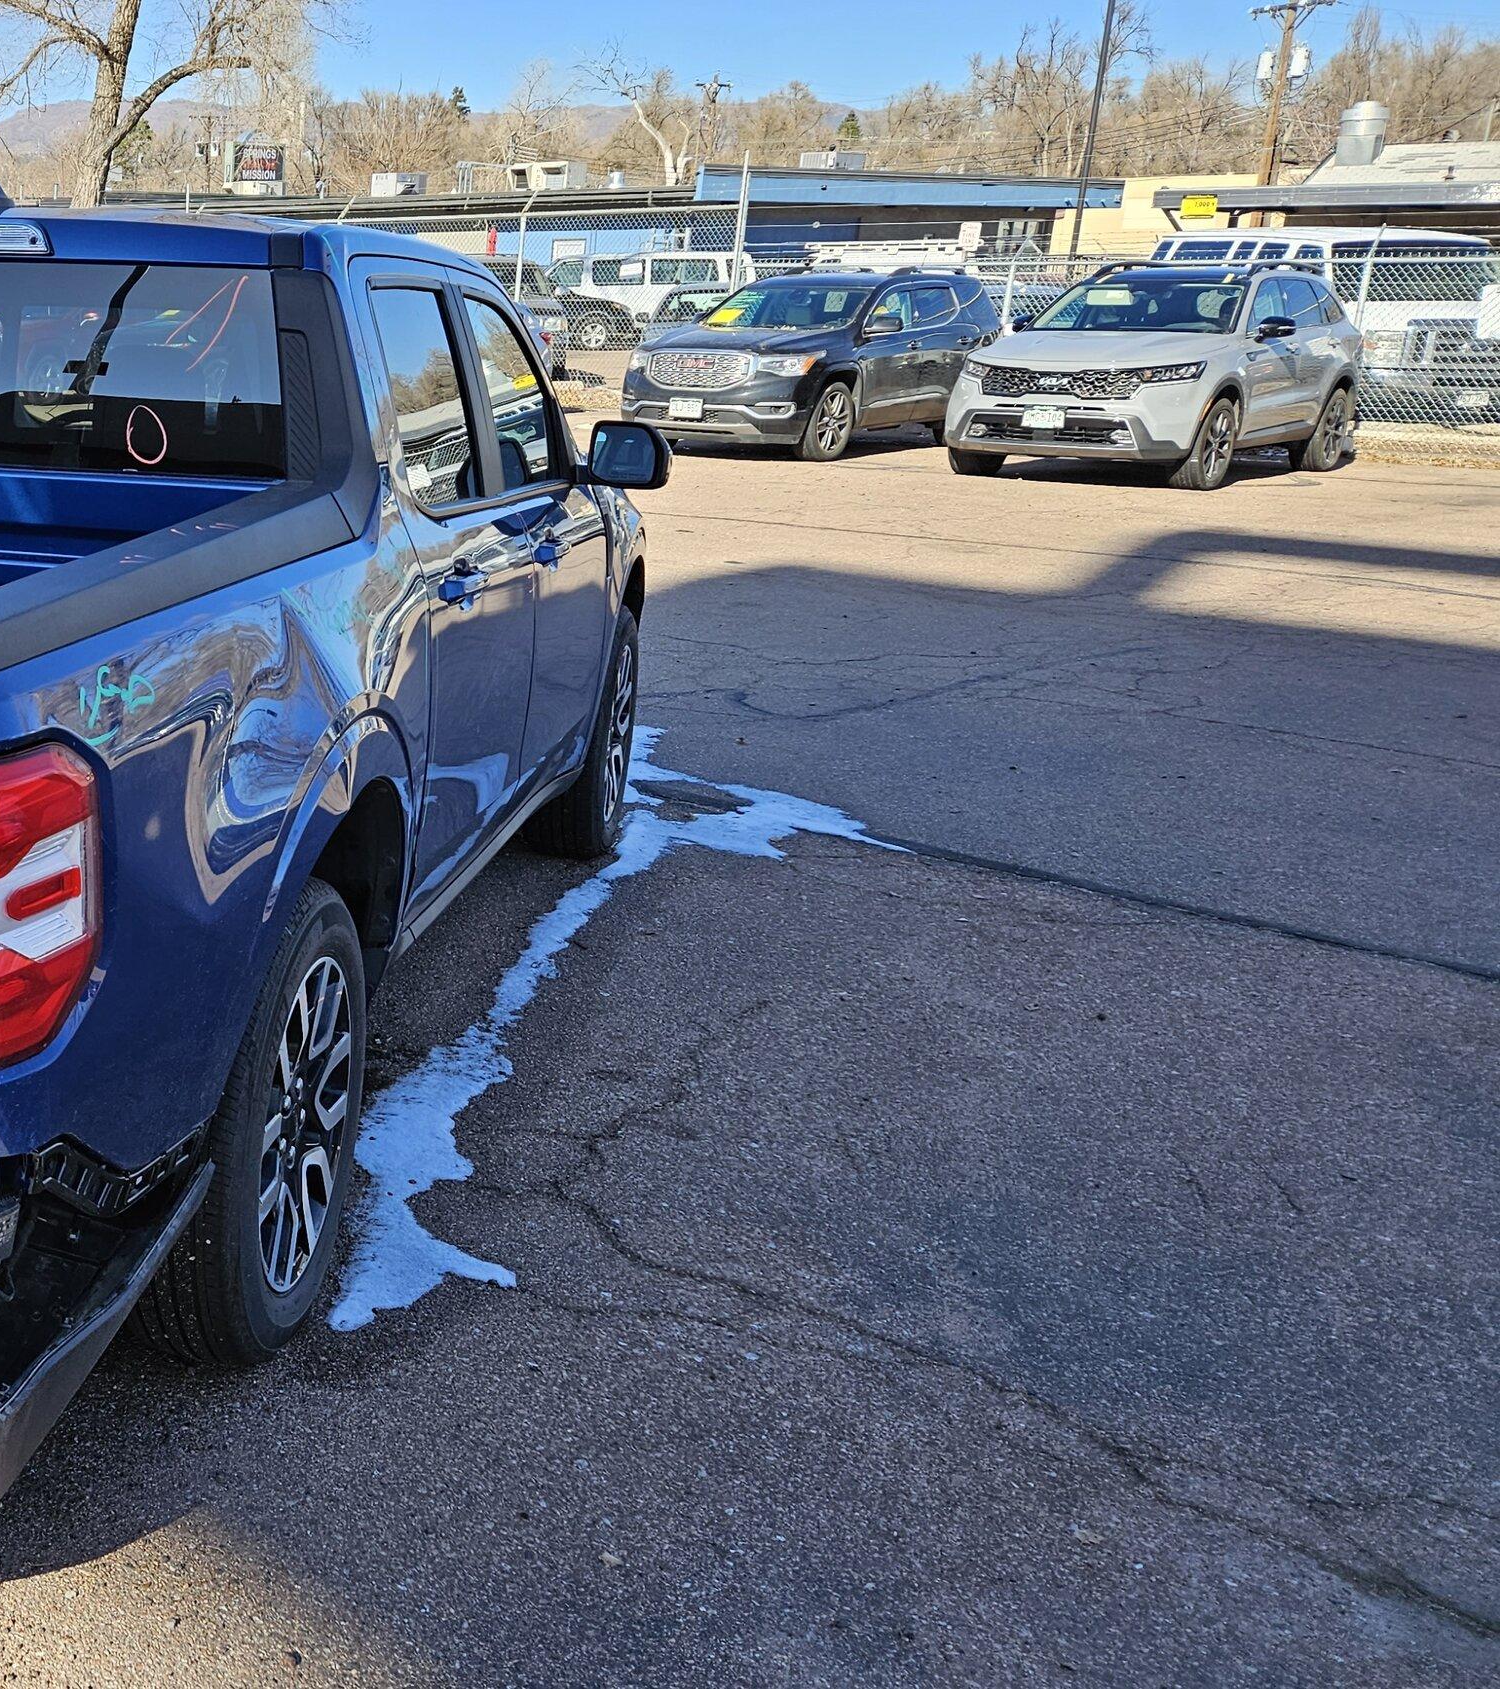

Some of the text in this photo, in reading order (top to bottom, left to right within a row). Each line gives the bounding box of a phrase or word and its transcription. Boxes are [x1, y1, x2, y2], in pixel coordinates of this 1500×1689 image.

[242, 148, 277, 159] SPRINGS
[242, 170, 276, 180] MISSION
[679, 358, 709, 369] GMC
